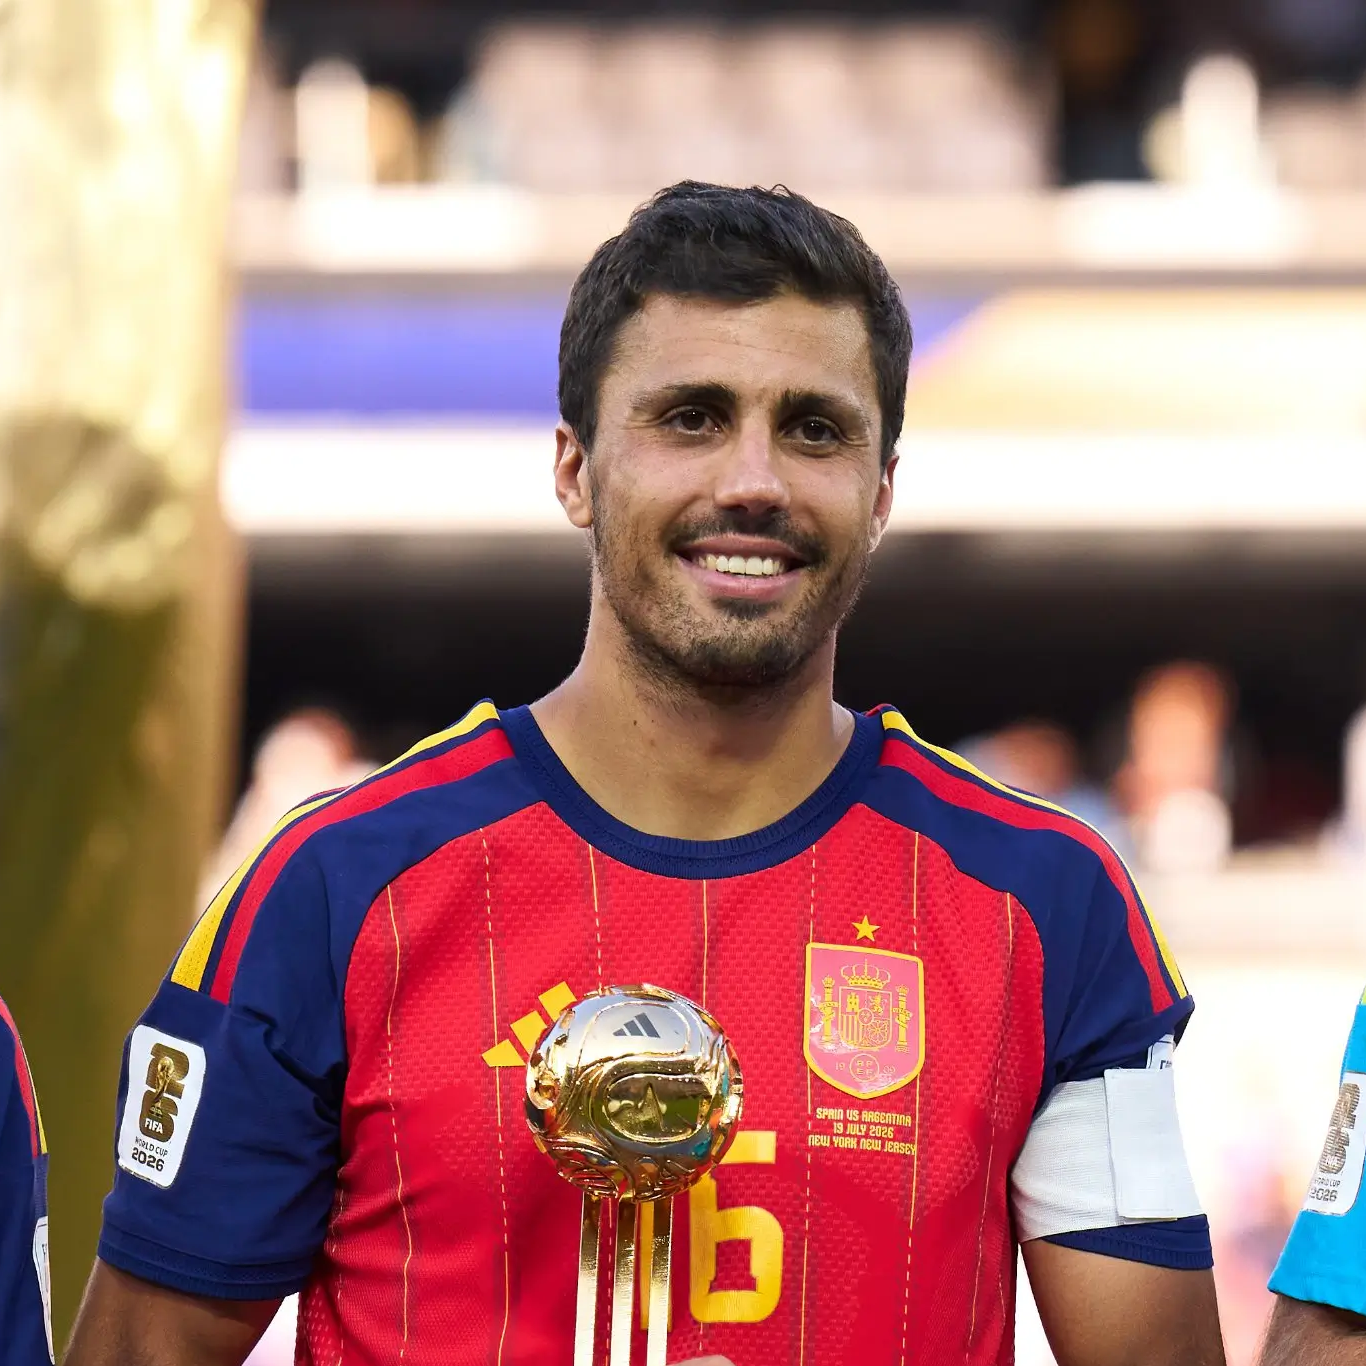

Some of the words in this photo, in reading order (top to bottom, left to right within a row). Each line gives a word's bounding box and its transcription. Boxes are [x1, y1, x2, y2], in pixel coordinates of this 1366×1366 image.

[144, 1118, 164, 1134] FIFA
[816, 1108, 843, 1120] SPAIN
[862, 1111, 911, 1127] ARGENTINA
[834, 1123, 843, 1134] 19
[846, 1123, 867, 1135] JULY
[870, 1126, 894, 1138] 2026
[135, 1136, 154, 1152] WORLD
[156, 1146, 168, 1157] CUP
[809, 1135, 830, 1147] NEW
[833, 1136, 857, 1149] YORK
[860, 1138, 881, 1151] NEW
[884, 1141, 916, 1155] JERSEY
[132, 1147, 165, 1172] 2026
[1309, 1187, 1338, 1201] 2026
